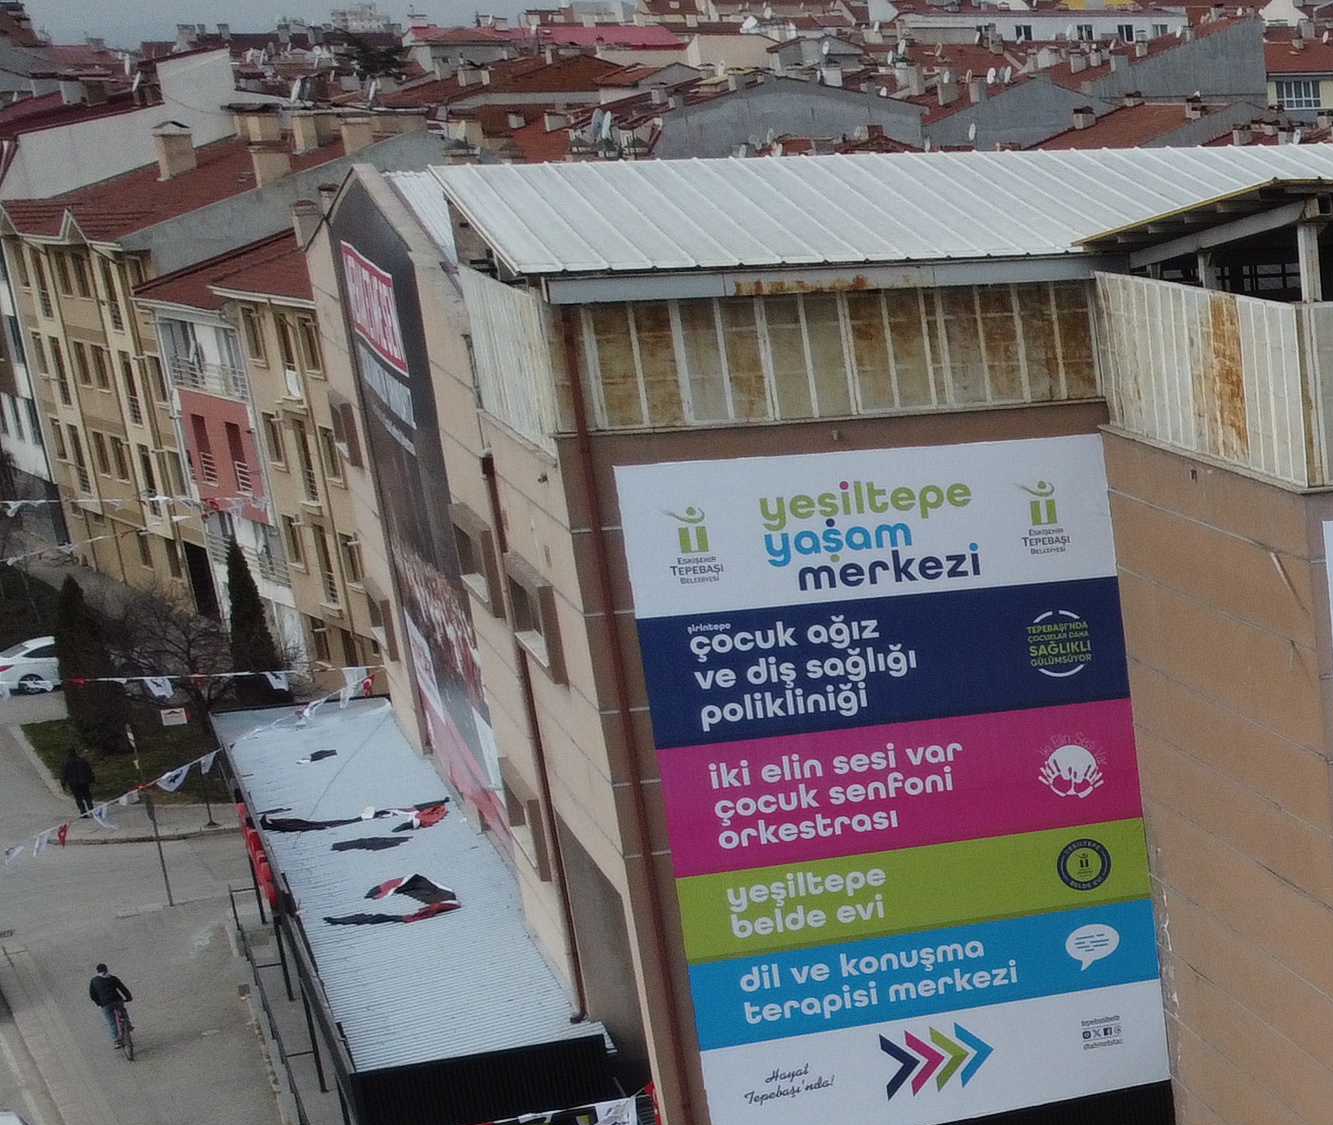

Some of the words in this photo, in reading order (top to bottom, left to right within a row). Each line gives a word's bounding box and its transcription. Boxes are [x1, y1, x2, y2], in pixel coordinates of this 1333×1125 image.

[799, 542, 981, 591] merkezi
[690, 621, 799, 663] çocuk
[807, 614, 880, 649] ağız
[1029, 640, 1092, 657] SAĞLIKLI
[694, 668, 737, 690] ve
[746, 656, 797, 688] diş
[806, 643, 917, 682] sağlığı
[701, 682, 868, 732] polikliniği
[708, 759, 751, 789] iki
[761, 753, 823, 783] elin
[832, 742, 896, 775] sesi
[905, 742, 963, 766] var
[714, 783, 820, 827] çocuk
[829, 766, 954, 805] senfoni
[718, 810, 899, 850] orkestrası
[726, 868, 887, 912] yeşiltepe
[730, 905, 827, 939] belde
[836, 893, 885, 924] evi
[739, 963, 780, 992] dil
[789, 962, 831, 985] ve
[839, 940, 985, 978] konuşma
[743, 980, 879, 1024] terapisi
[888, 959, 1018, 1003] merkezi
[765, 1063, 809, 1083] Hayat
